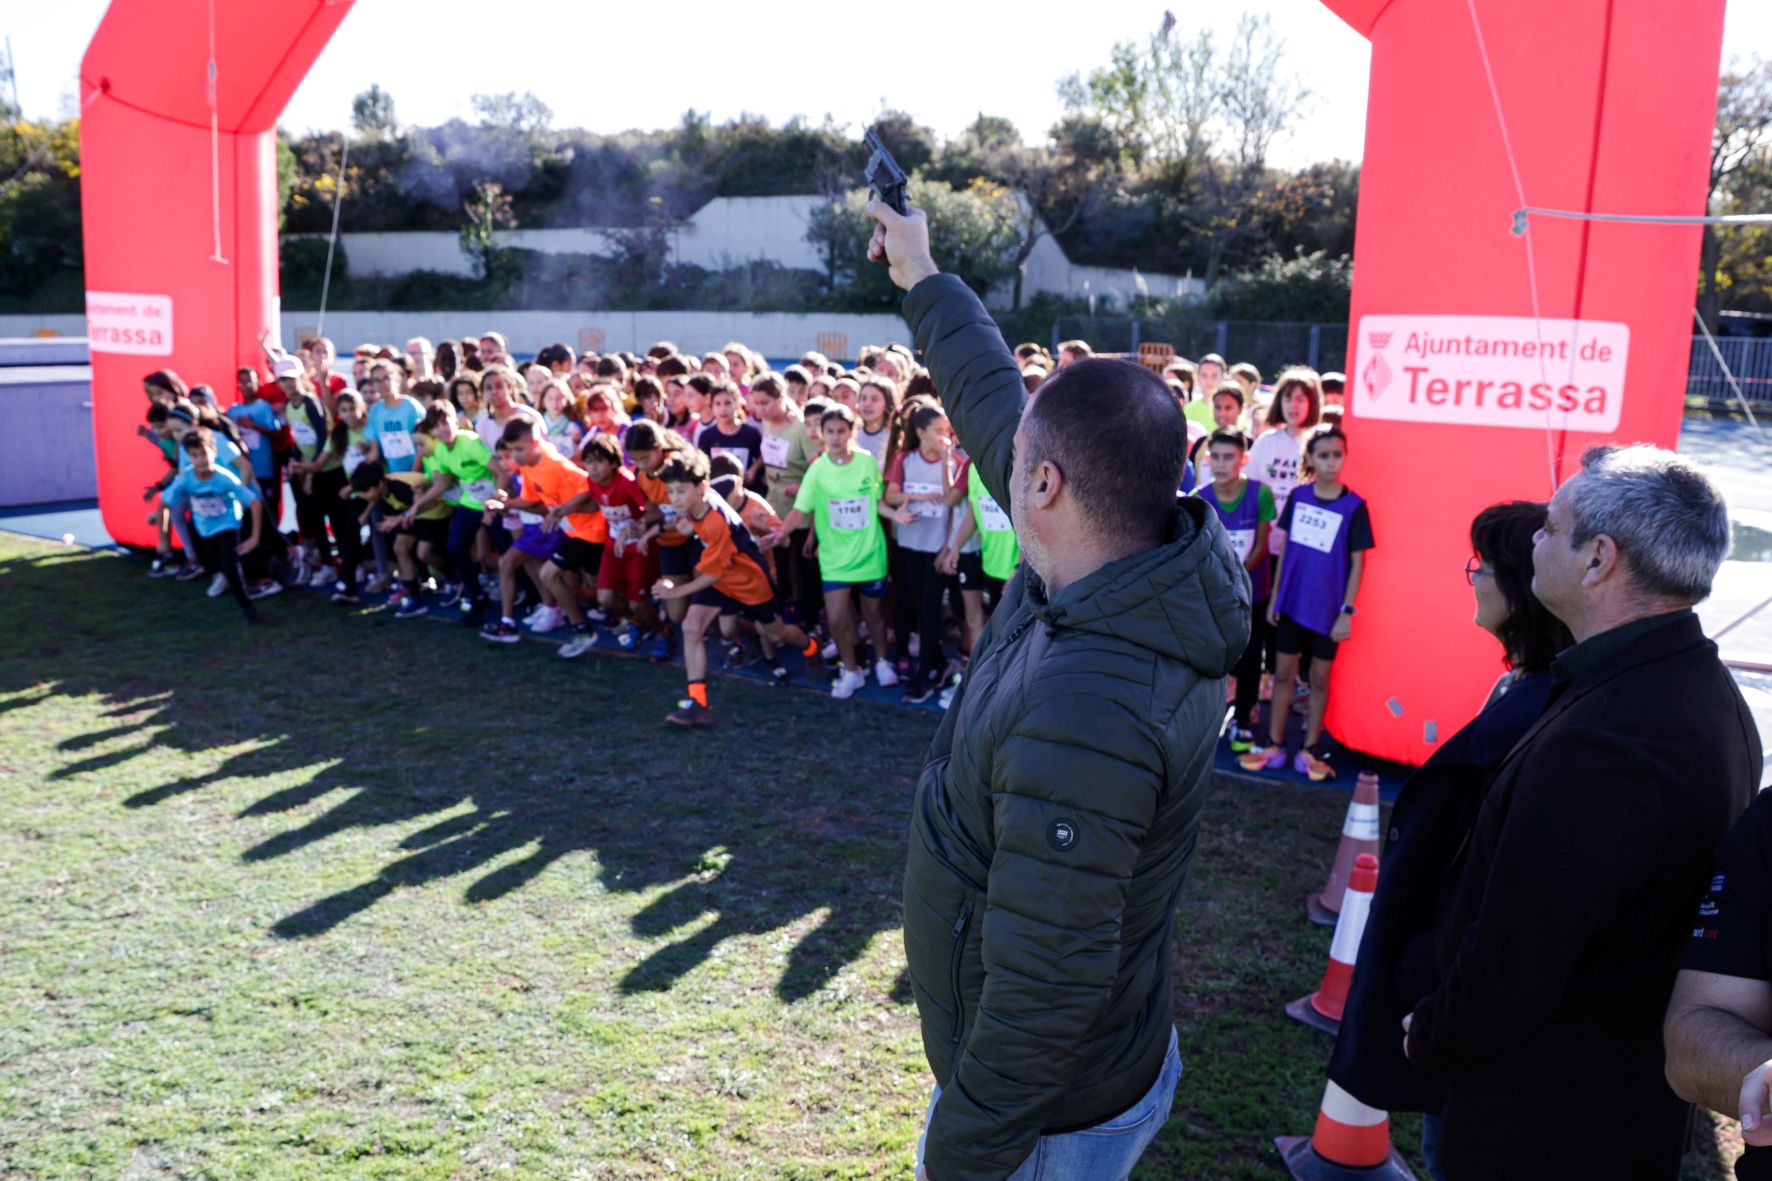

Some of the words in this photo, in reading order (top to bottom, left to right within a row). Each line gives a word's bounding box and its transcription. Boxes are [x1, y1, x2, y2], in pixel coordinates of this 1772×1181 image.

[142, 304, 162, 317] de
[89, 326, 162, 345] errassa
[1404, 331, 1568, 360] Ajuntament
[1579, 339, 1612, 362] de
[1403, 366, 1608, 415] Terrassa
